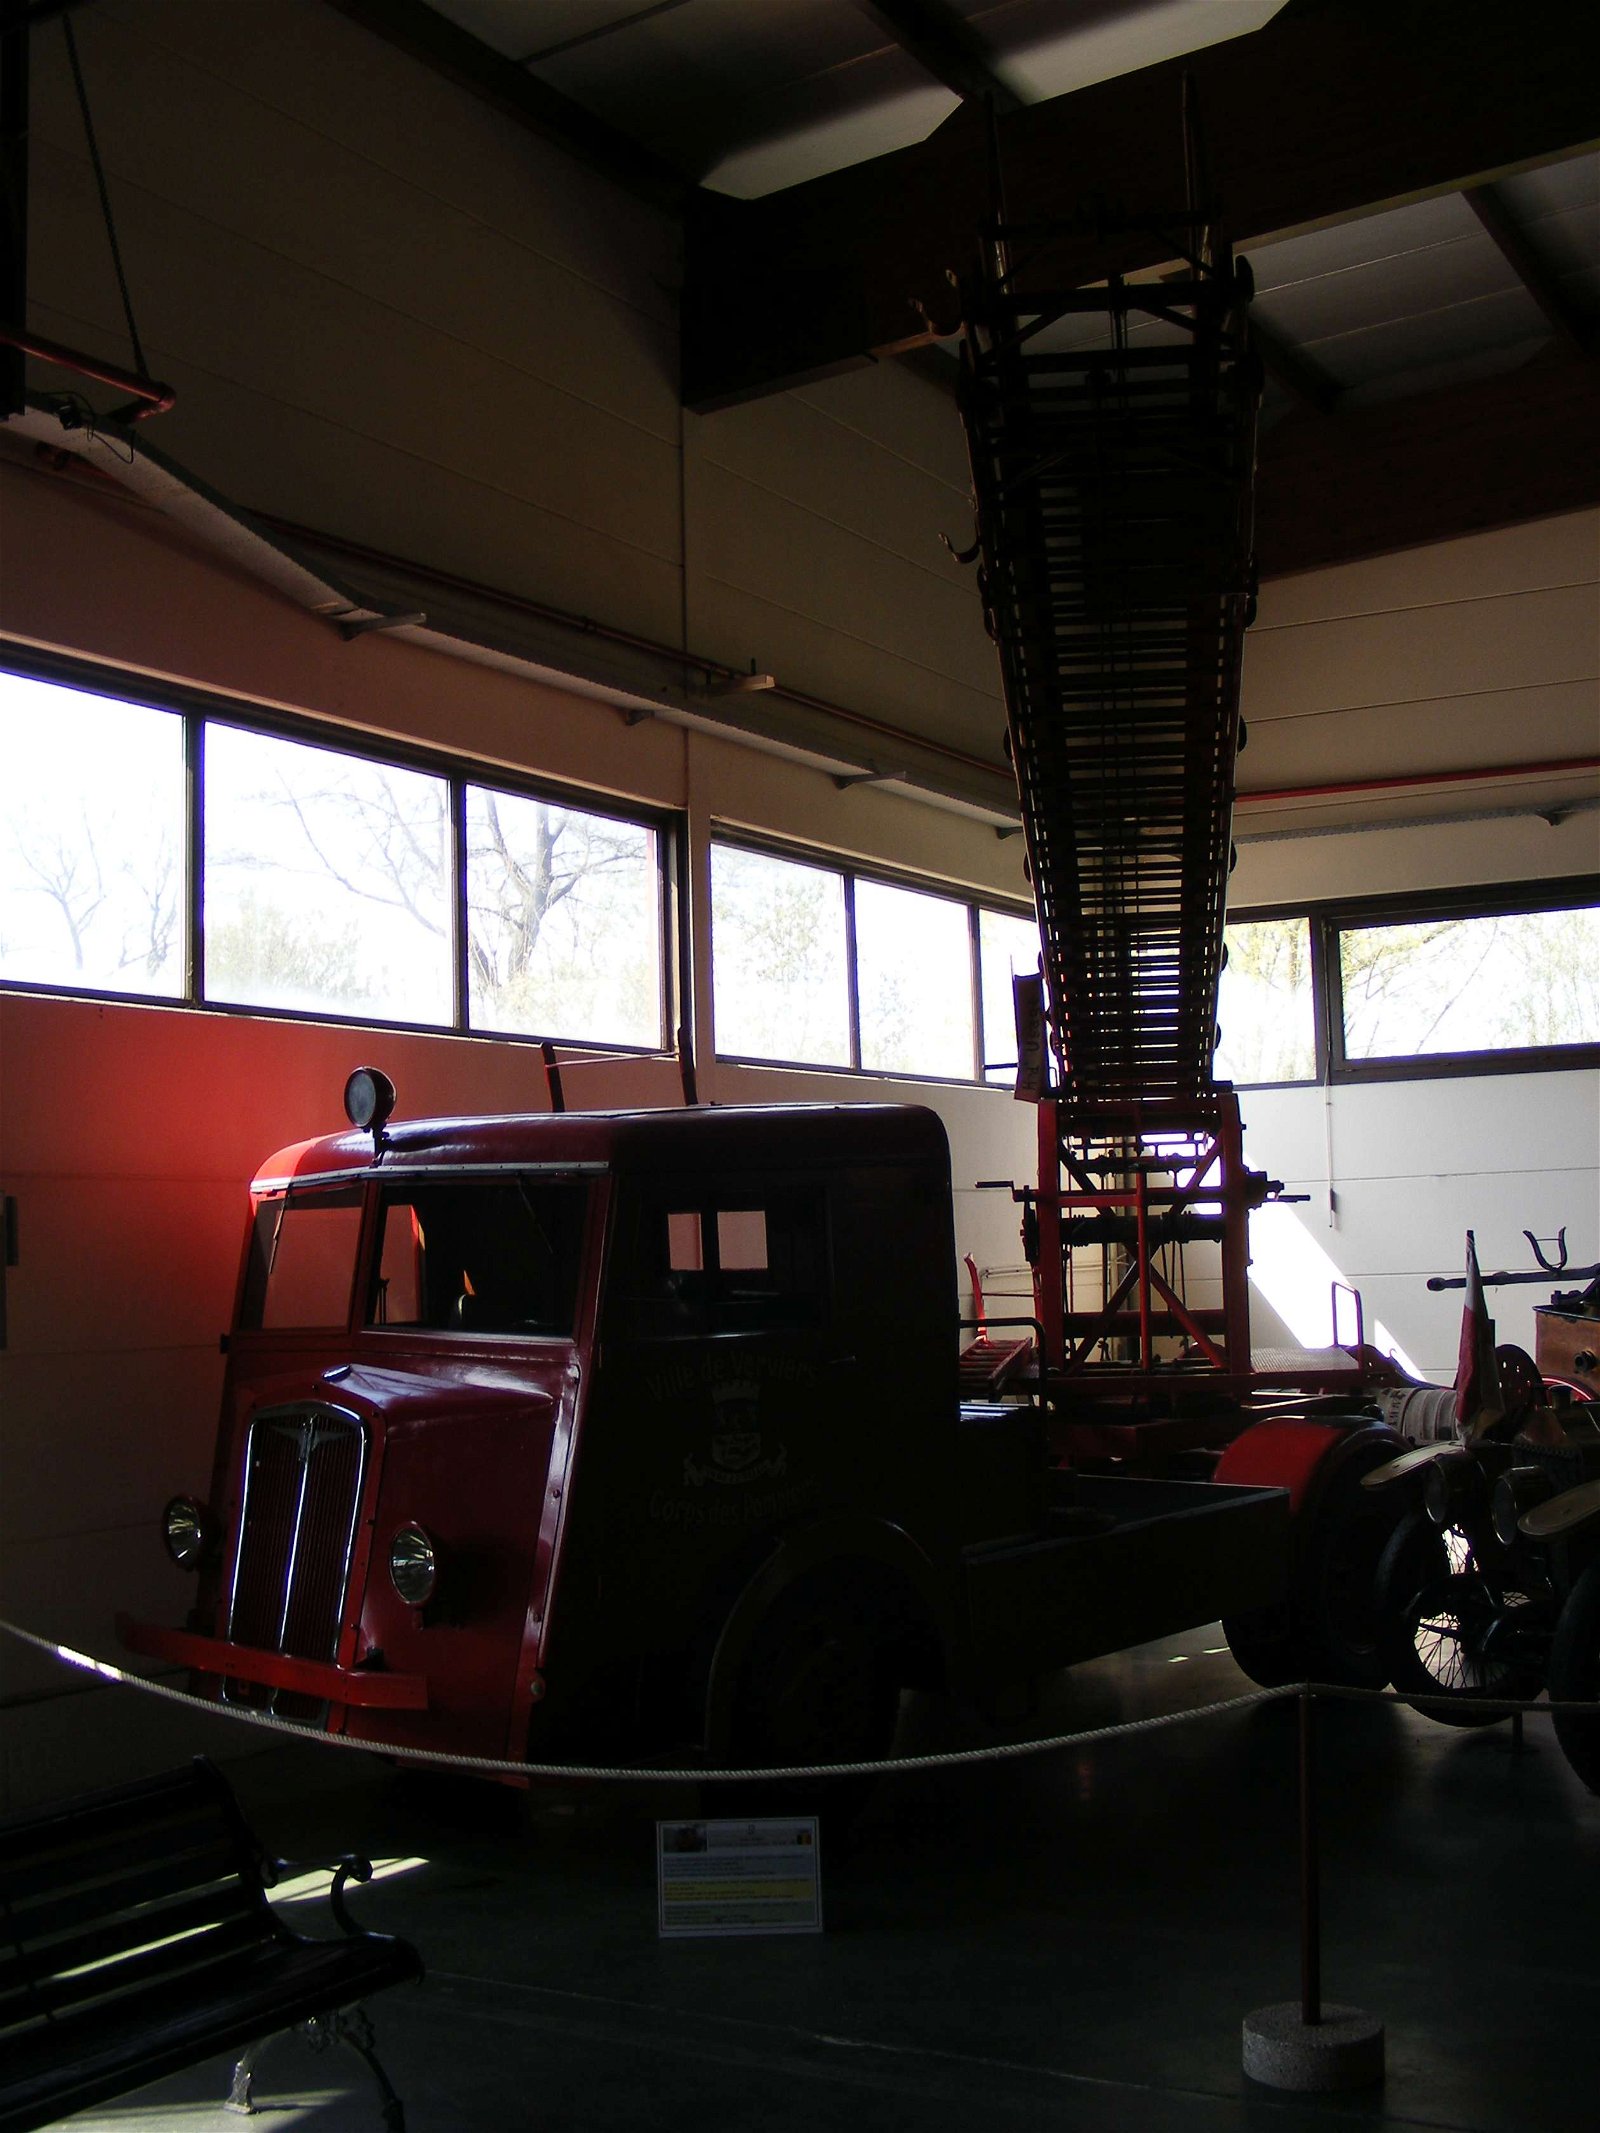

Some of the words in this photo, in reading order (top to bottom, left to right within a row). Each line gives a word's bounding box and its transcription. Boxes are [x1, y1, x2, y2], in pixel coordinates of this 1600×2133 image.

[645, 1361, 696, 1402] Ville
[701, 1352, 725, 1382] de
[708, 1498, 737, 1525] des
